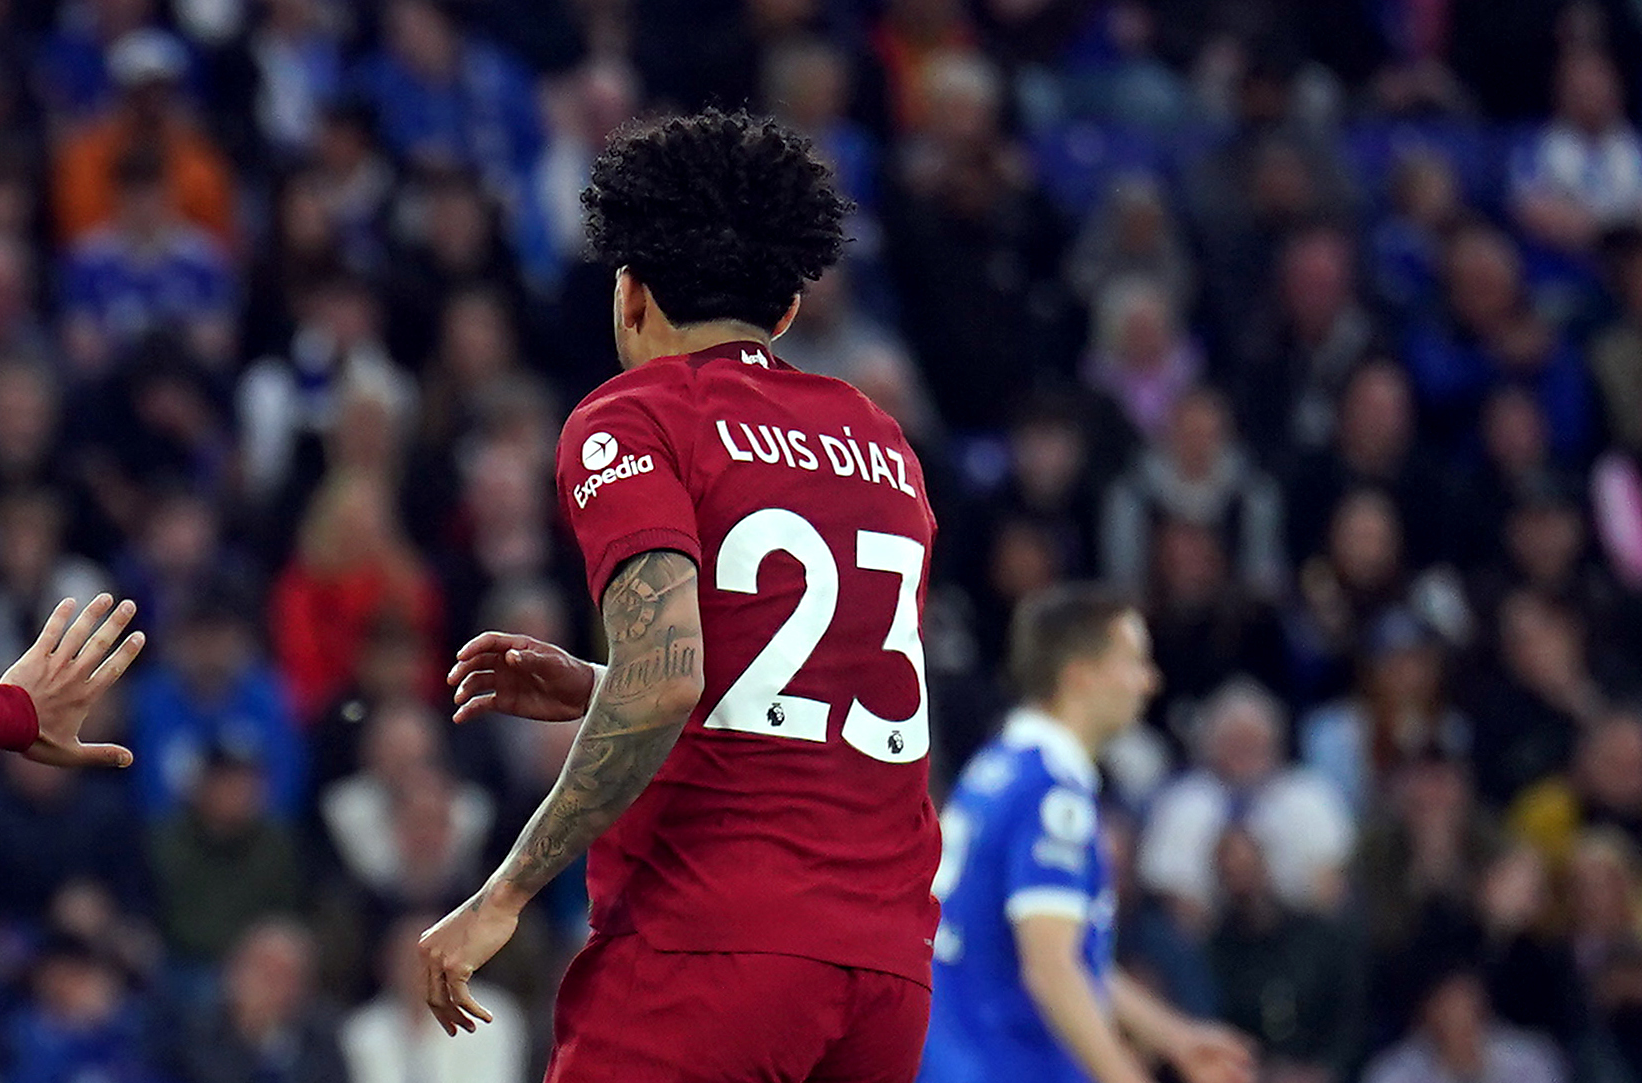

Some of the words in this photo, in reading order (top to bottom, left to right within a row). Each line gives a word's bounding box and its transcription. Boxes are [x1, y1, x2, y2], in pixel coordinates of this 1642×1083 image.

[573, 454, 654, 508] Expedia
[715, 420, 819, 471] LUIS
[820, 426, 916, 498] DÍAZ
[704, 508, 931, 764] 23
